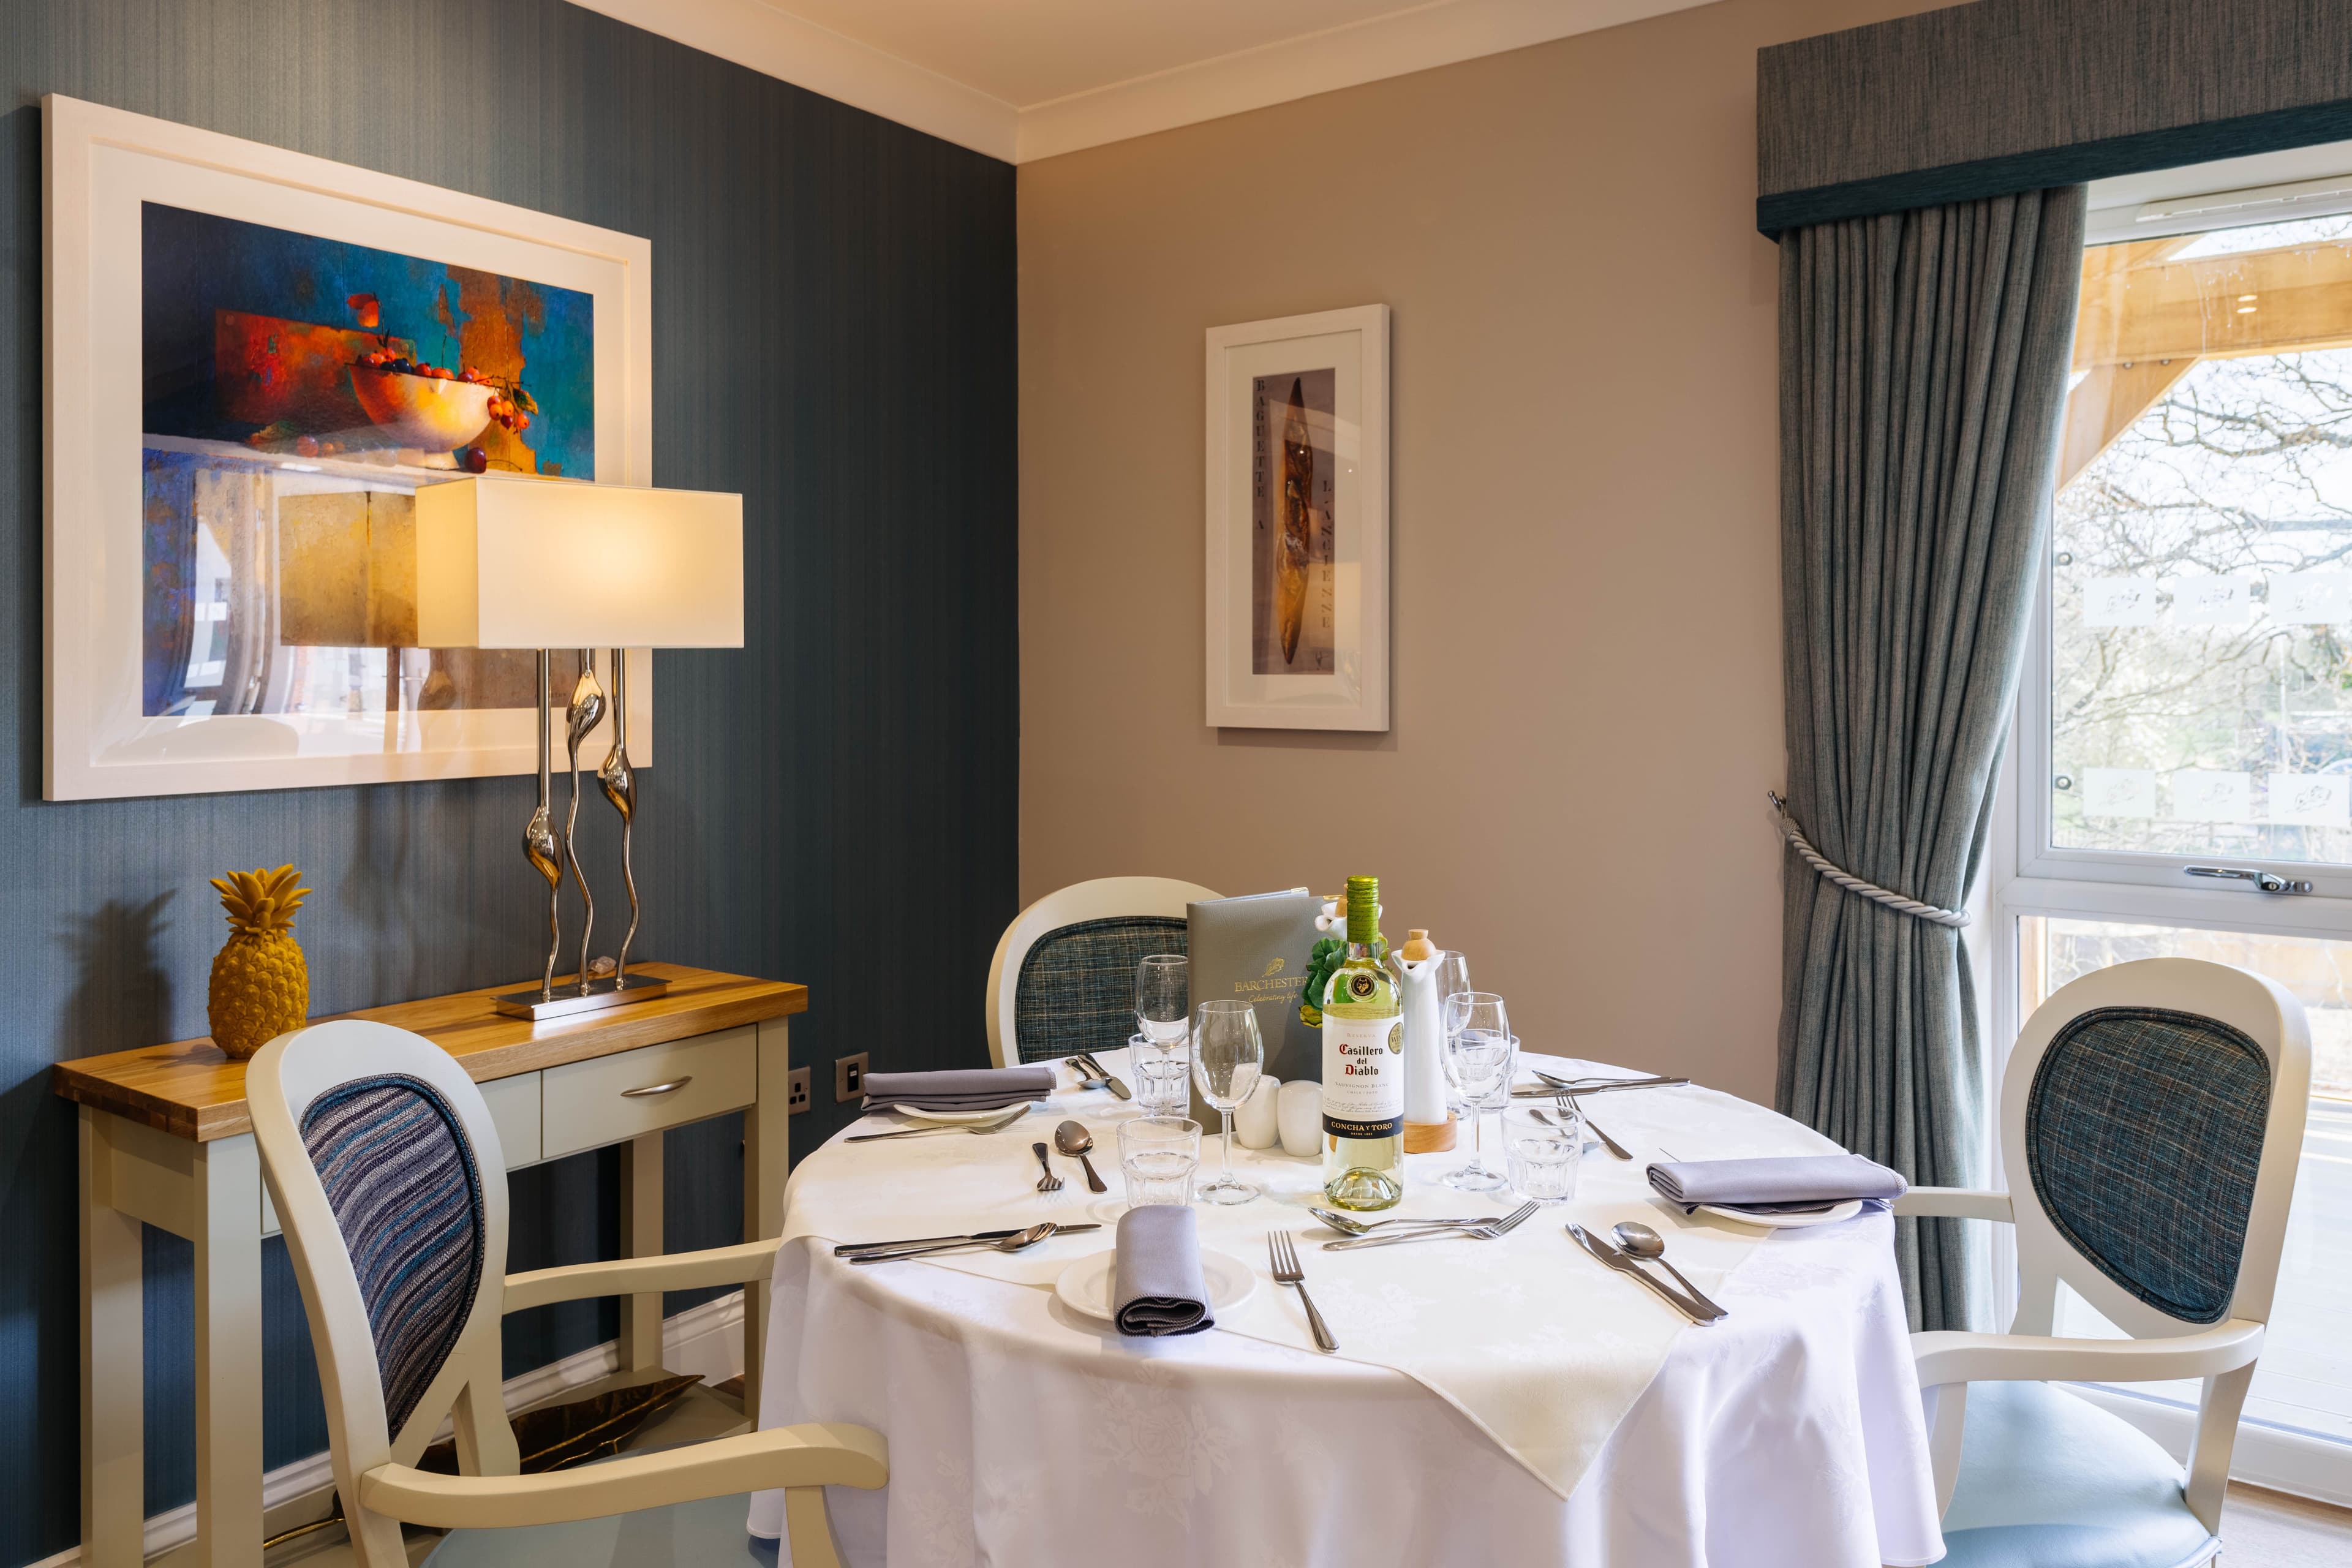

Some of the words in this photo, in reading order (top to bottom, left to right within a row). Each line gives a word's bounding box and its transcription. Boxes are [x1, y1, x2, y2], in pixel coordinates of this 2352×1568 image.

[1256, 379, 1265, 498] BAGUETTE
[1234, 976, 1308, 992] BARCHESTER
[1248, 993, 1285, 1004] Celebrating
[1286, 990, 1298, 1003] life
[1339, 1043, 1383, 1055] Casillero
[1345, 1064, 1379, 1076] Diablo
[1331, 1121, 1365, 1131] CONCHA
[1371, 1122, 1393, 1131] TORO
